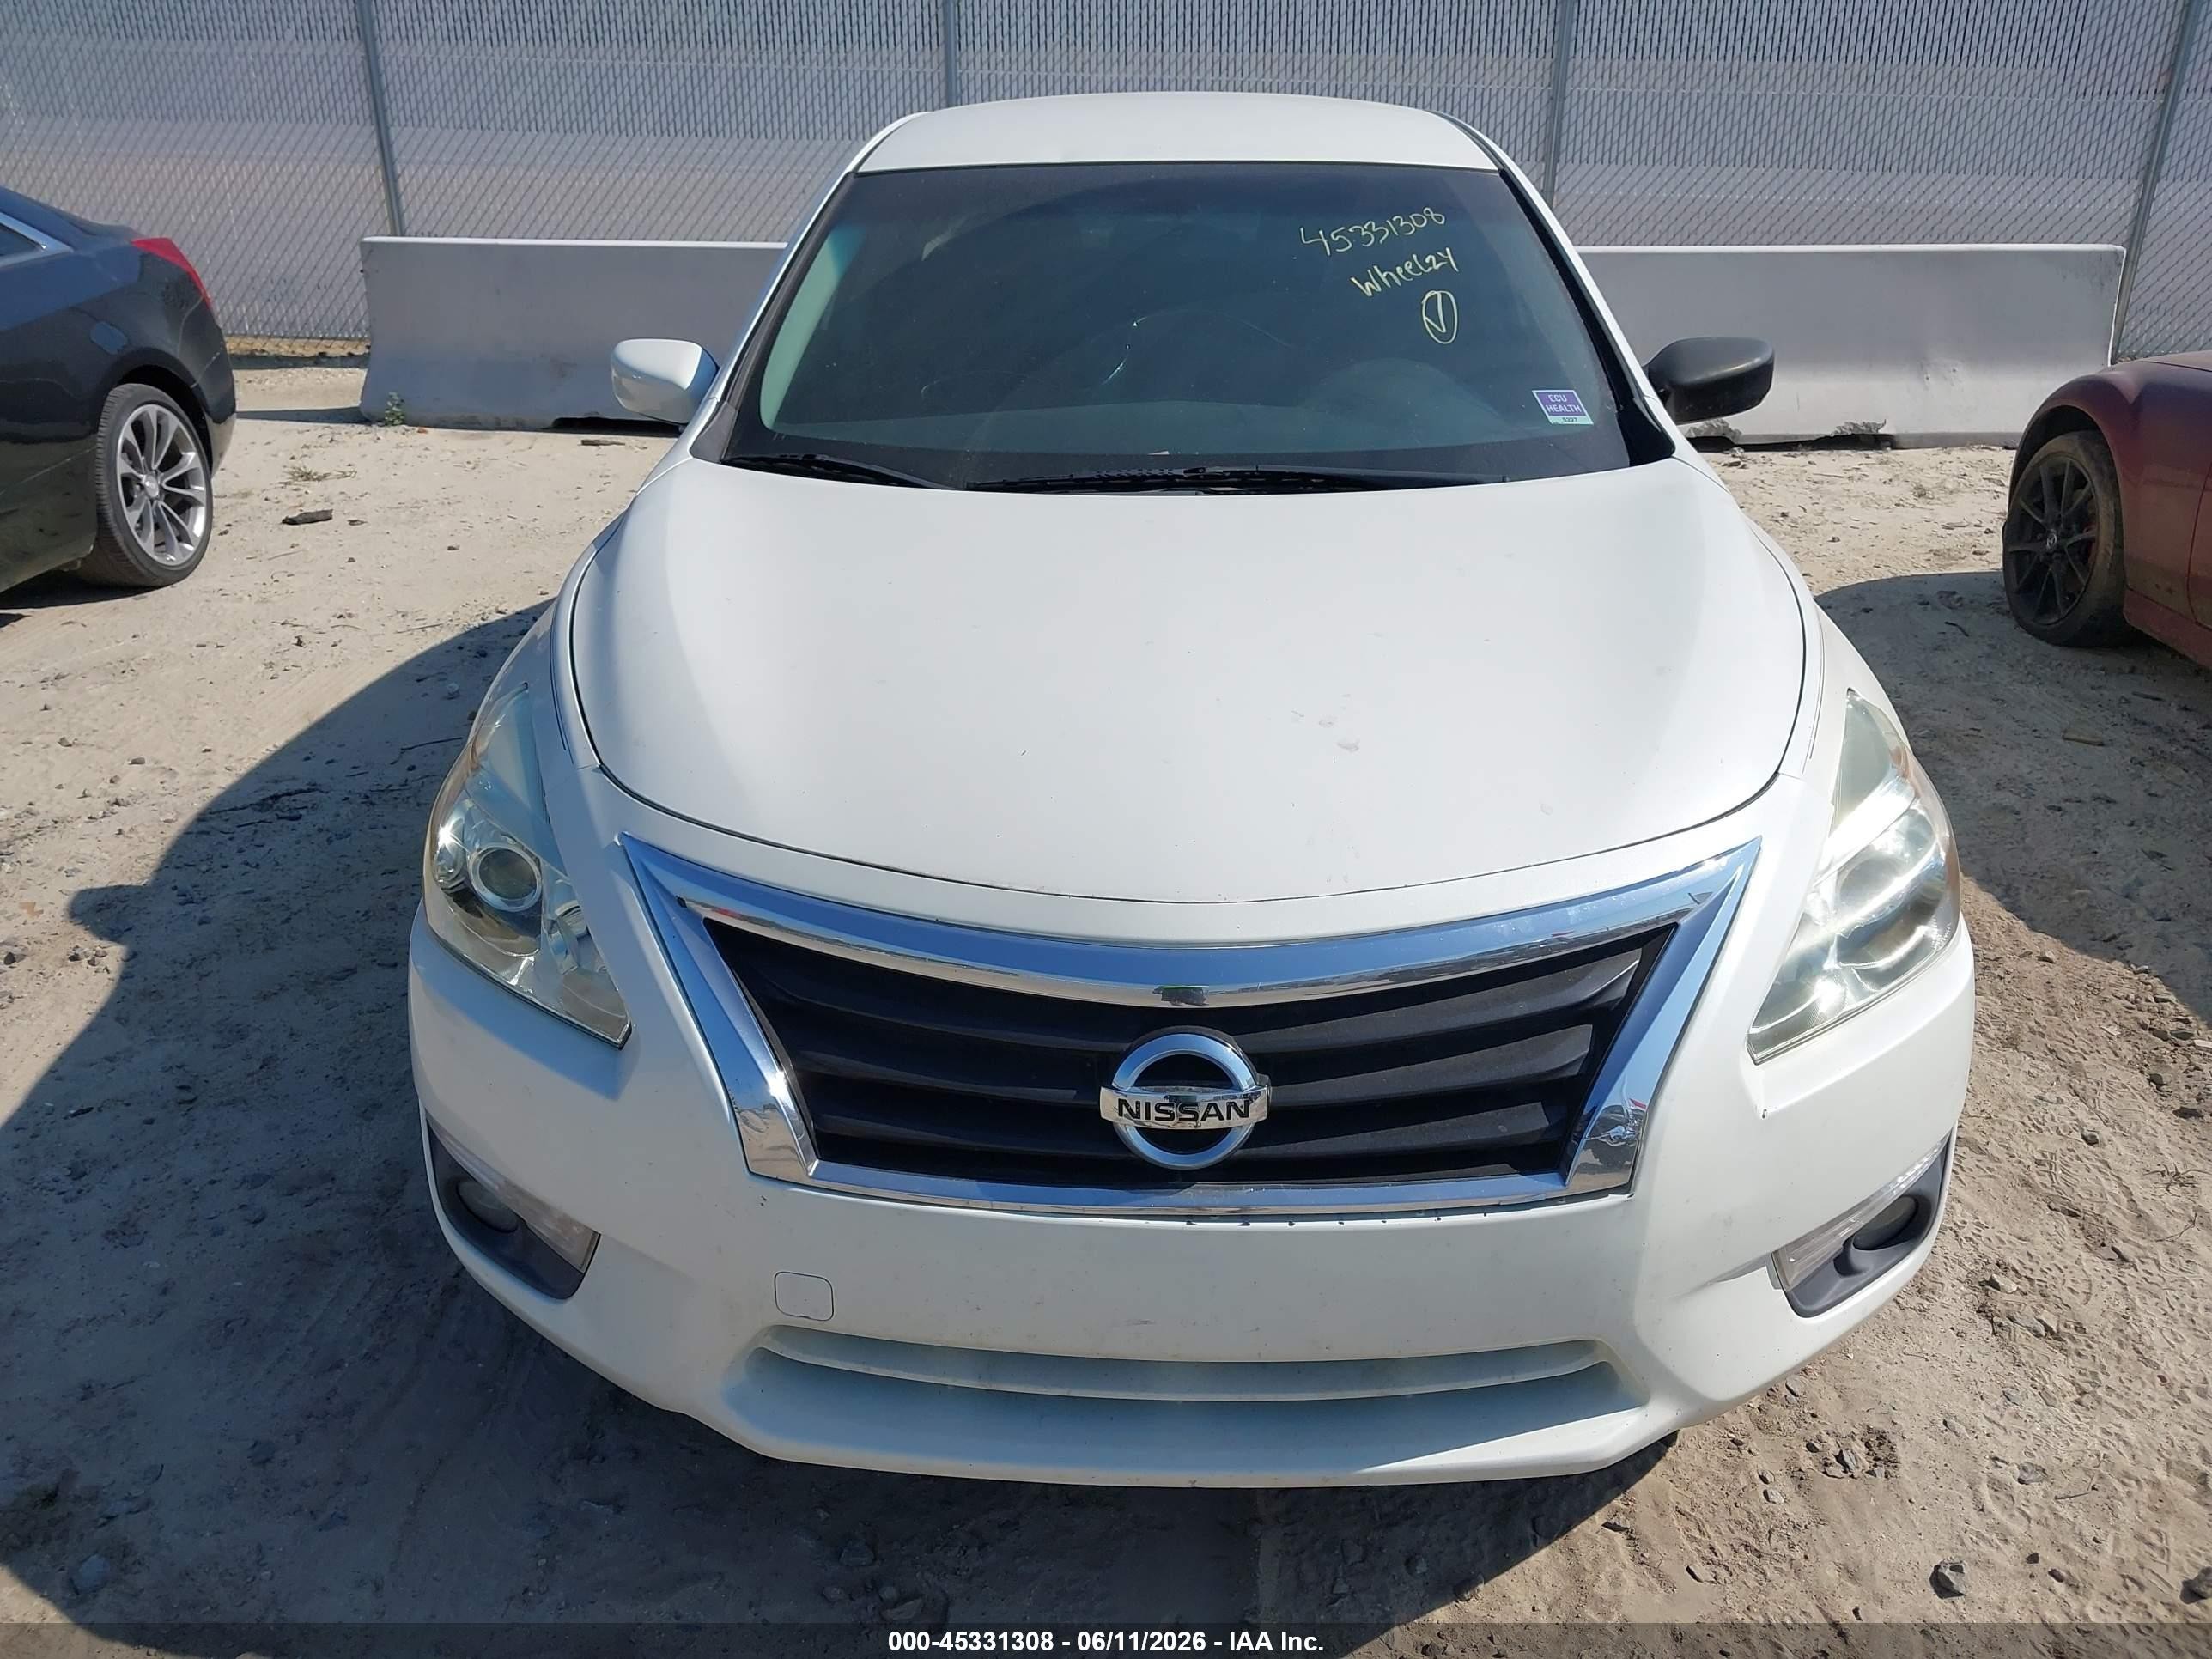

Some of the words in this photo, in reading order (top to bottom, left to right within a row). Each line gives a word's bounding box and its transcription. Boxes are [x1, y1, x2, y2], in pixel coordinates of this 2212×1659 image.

[1299, 206, 1446, 256] 45331308
[1546, 404, 1582, 413] HEALTH
[1117, 1097, 1250, 1122] NISSAN
